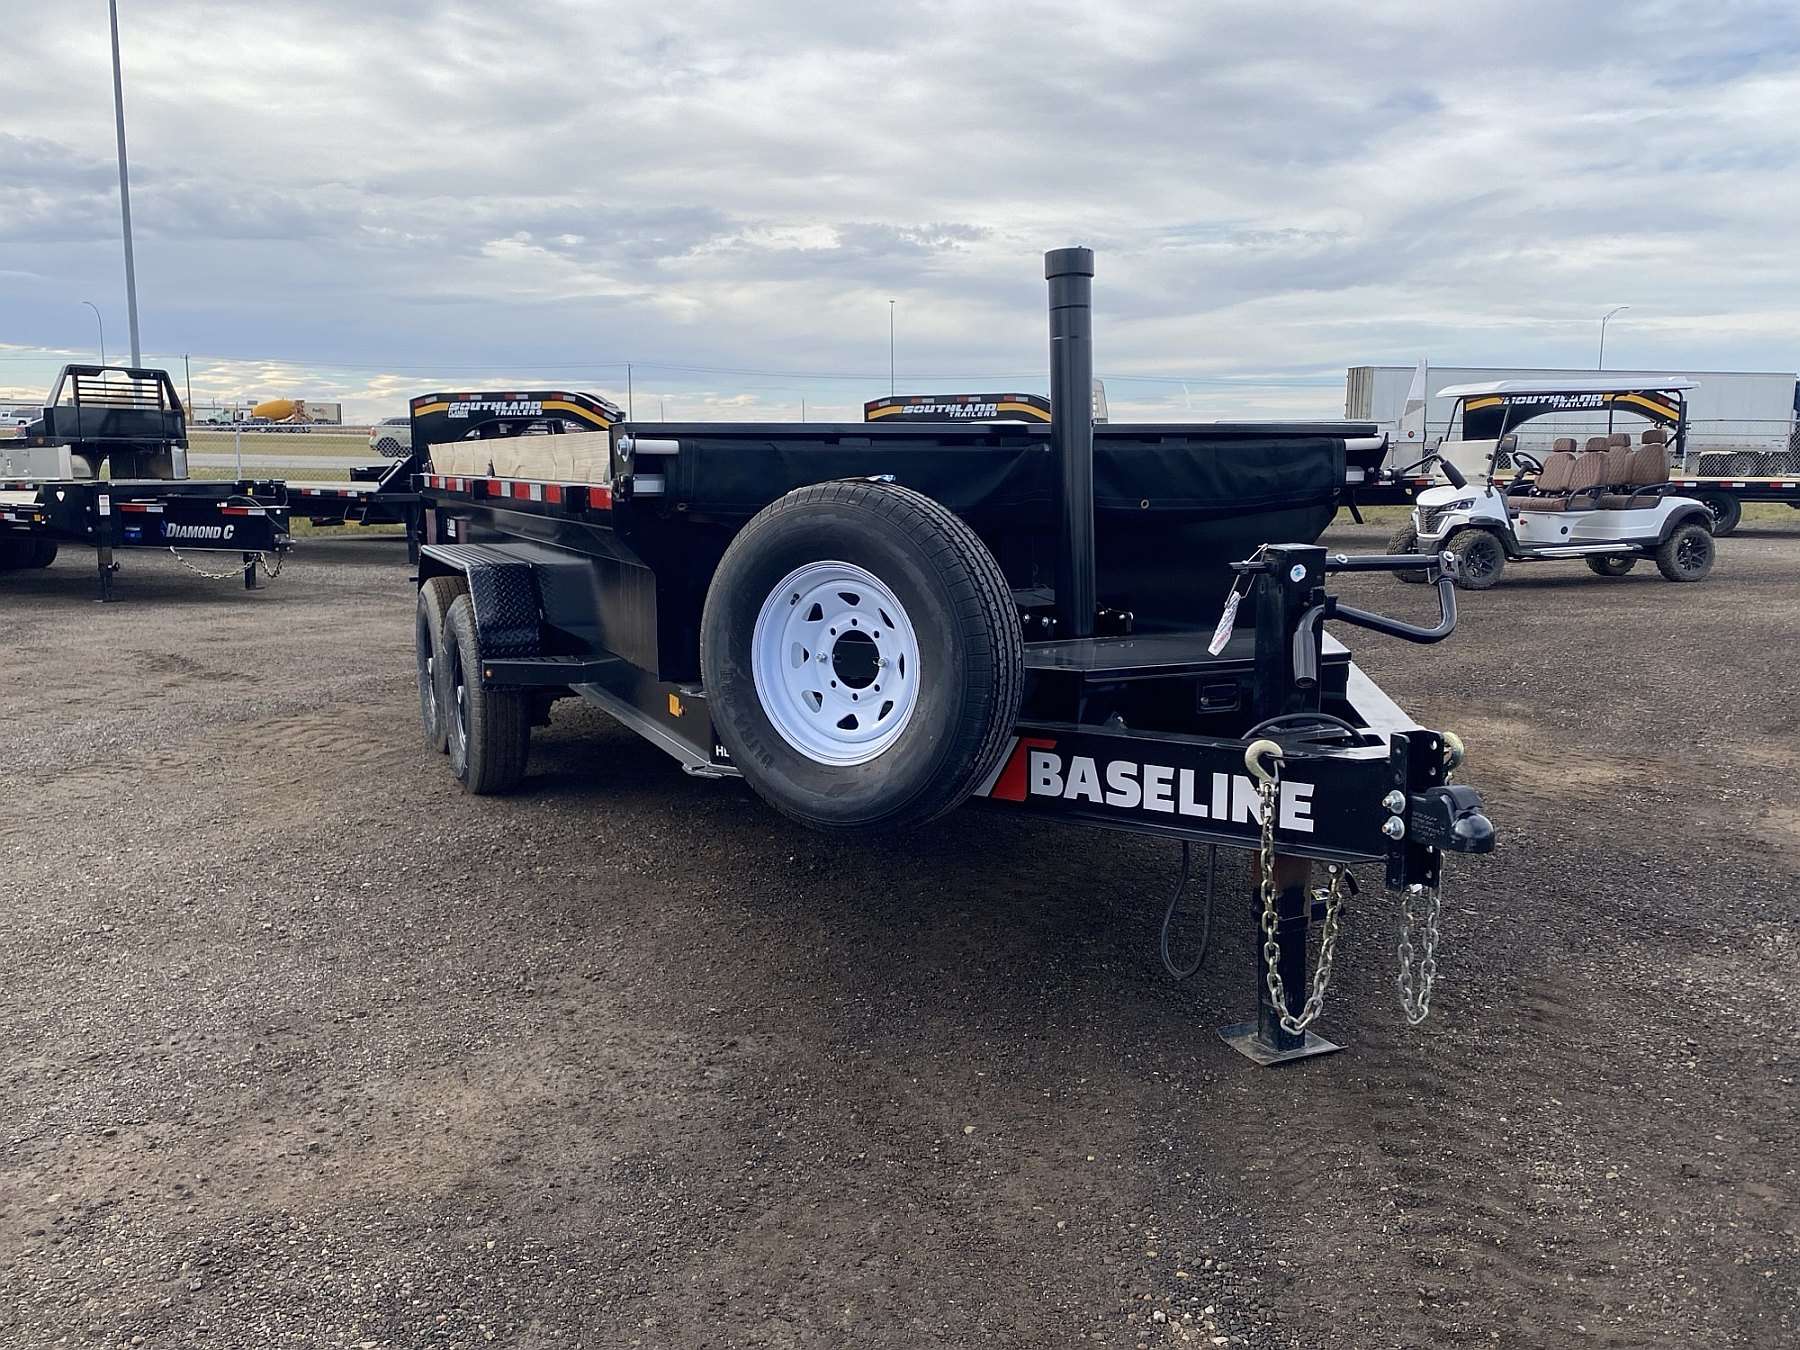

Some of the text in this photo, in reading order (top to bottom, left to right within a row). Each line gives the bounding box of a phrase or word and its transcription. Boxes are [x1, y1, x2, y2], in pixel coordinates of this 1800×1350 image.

[449, 401, 542, 411] SOUTHLAND
[902, 403, 997, 414] SOUTHLAND
[948, 410, 997, 418] TRAILERS
[223, 524, 235, 540] C
[1030, 750, 1314, 832] BASELINE
